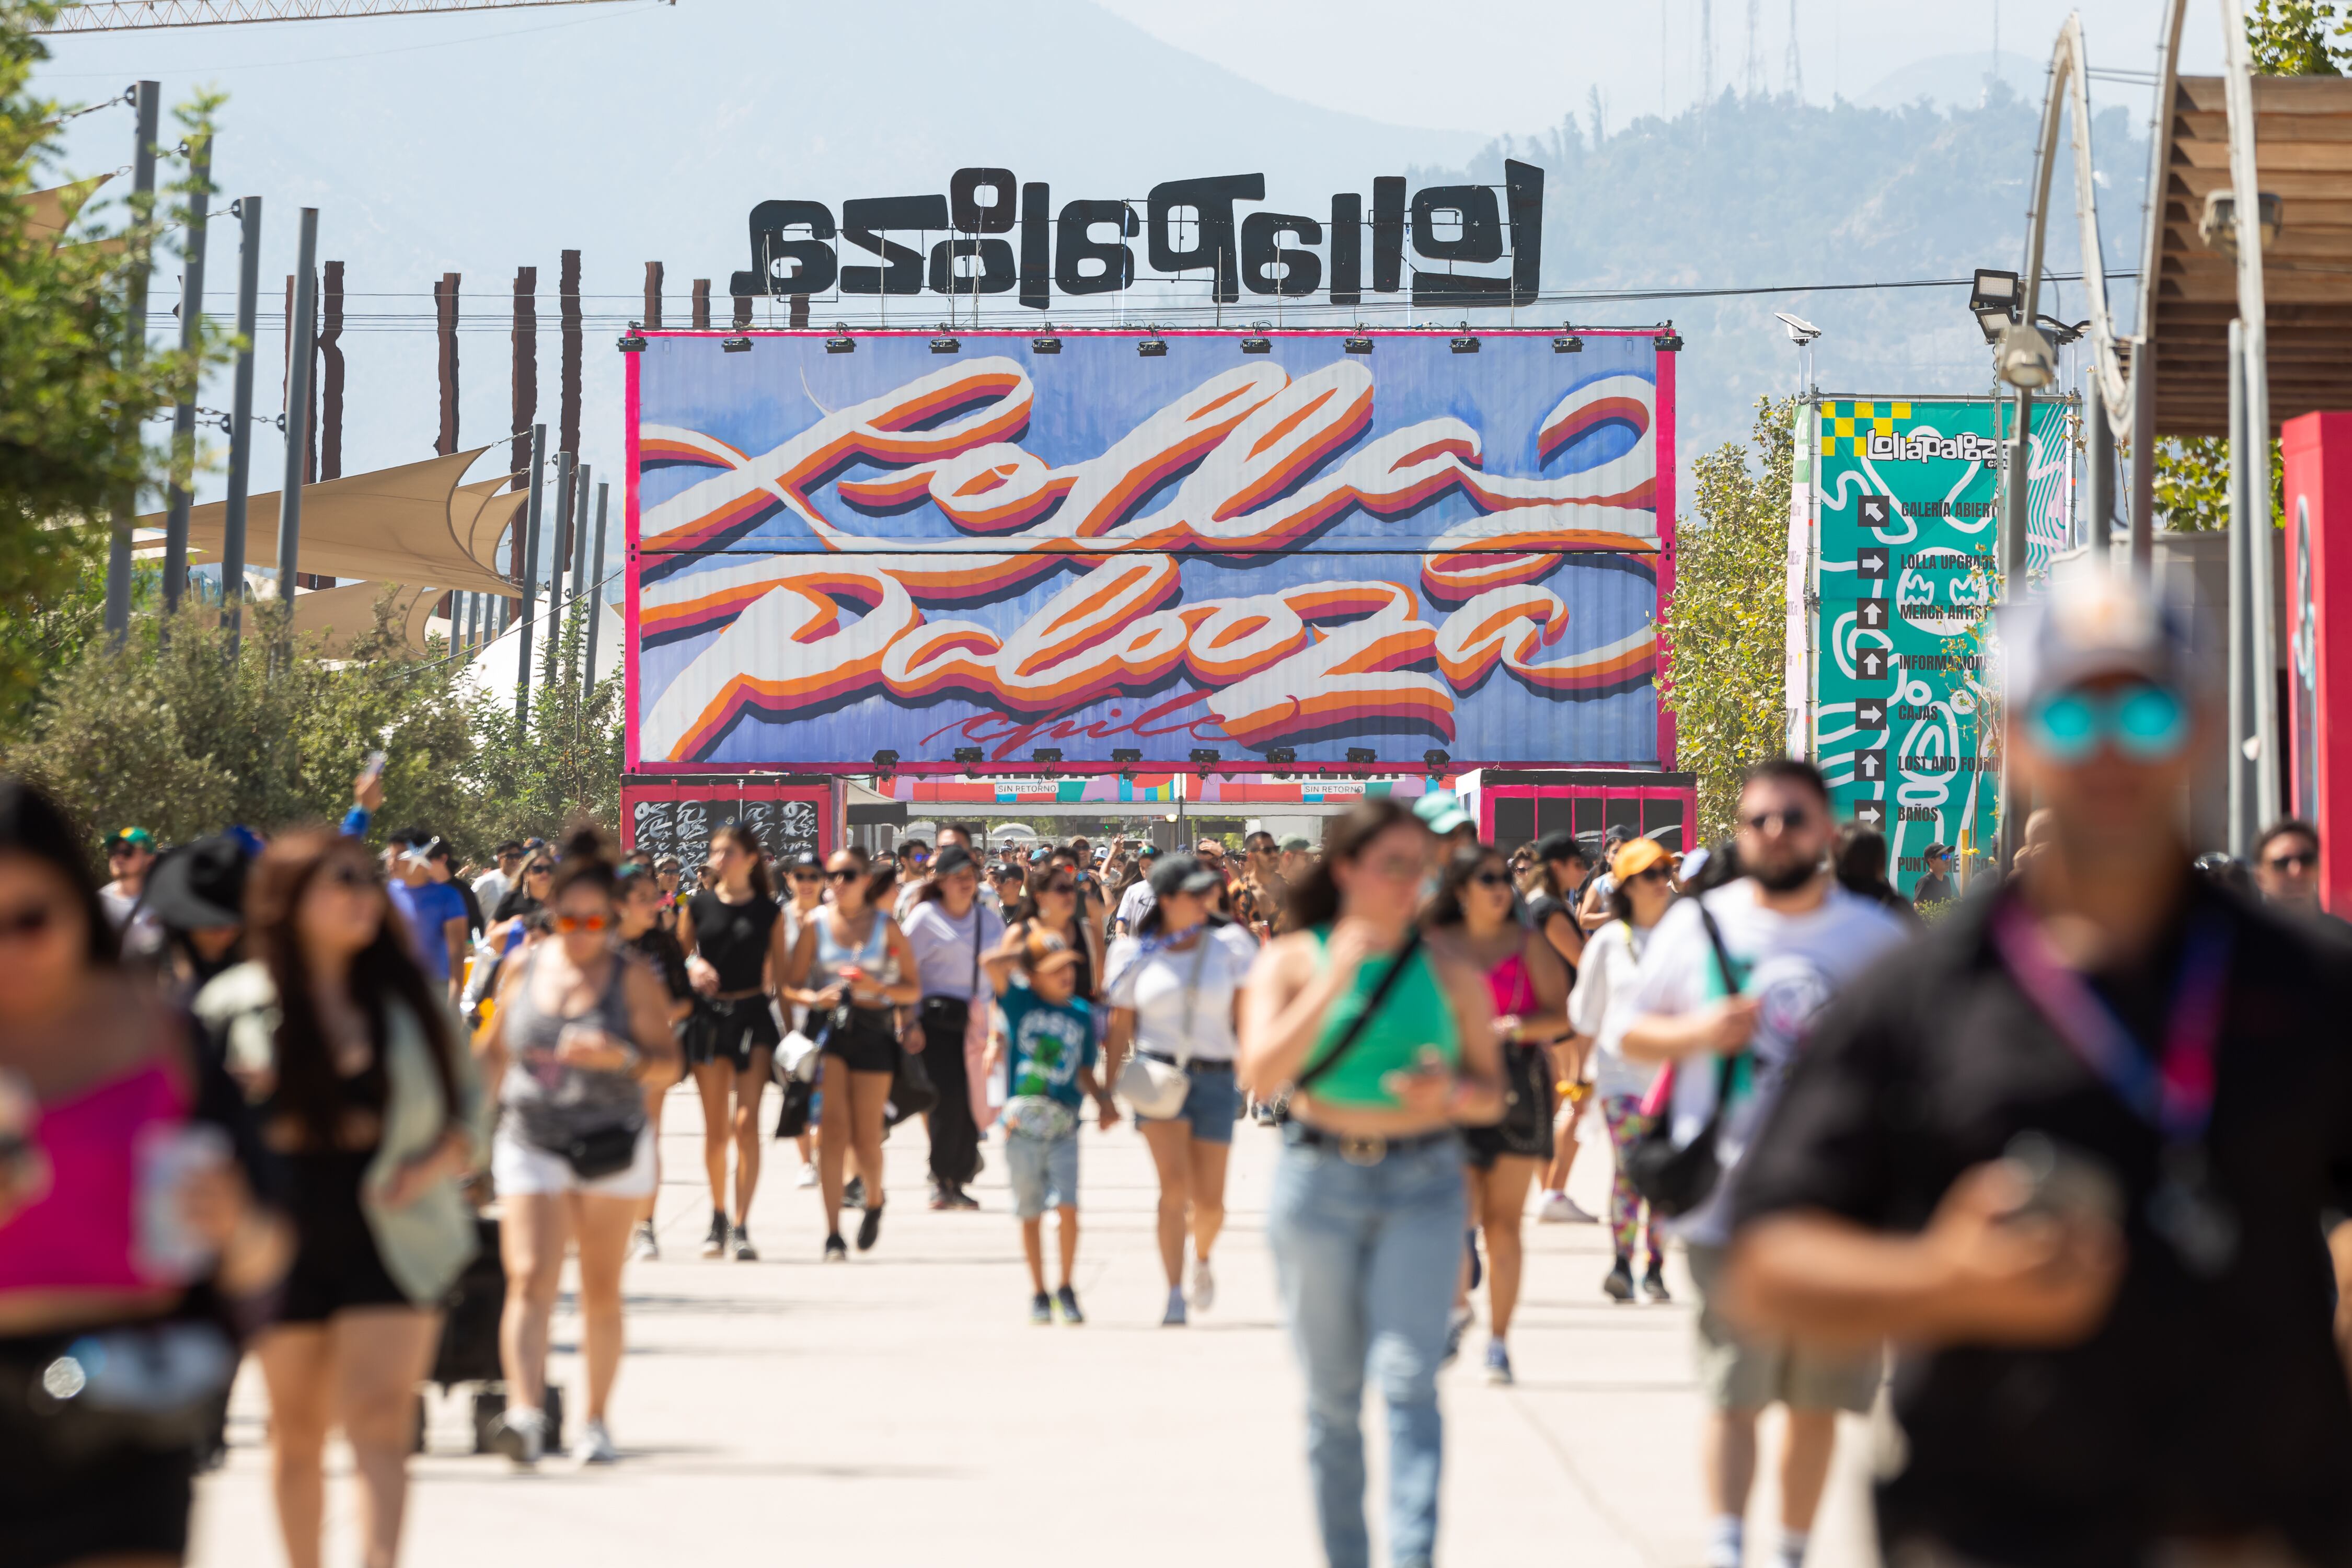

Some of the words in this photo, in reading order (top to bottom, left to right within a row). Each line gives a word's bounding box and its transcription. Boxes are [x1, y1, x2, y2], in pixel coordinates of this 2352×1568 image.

[640, 356, 1656, 555] Lolla
[1901, 498, 1951, 517] GALERÍA
[1955, 502, 1995, 517] ABIERT
[1900, 554, 1936, 569] LOLLA
[1900, 604, 1943, 619] MERCH
[1899, 655, 1988, 671] INFORMACION
[1898, 705, 1938, 720] CAJAS
[1898, 756, 1927, 771] LOST
[1931, 756, 1956, 771] AND
[1898, 804, 1938, 822] BAÑOS
[1898, 857, 1928, 872] PUNT
